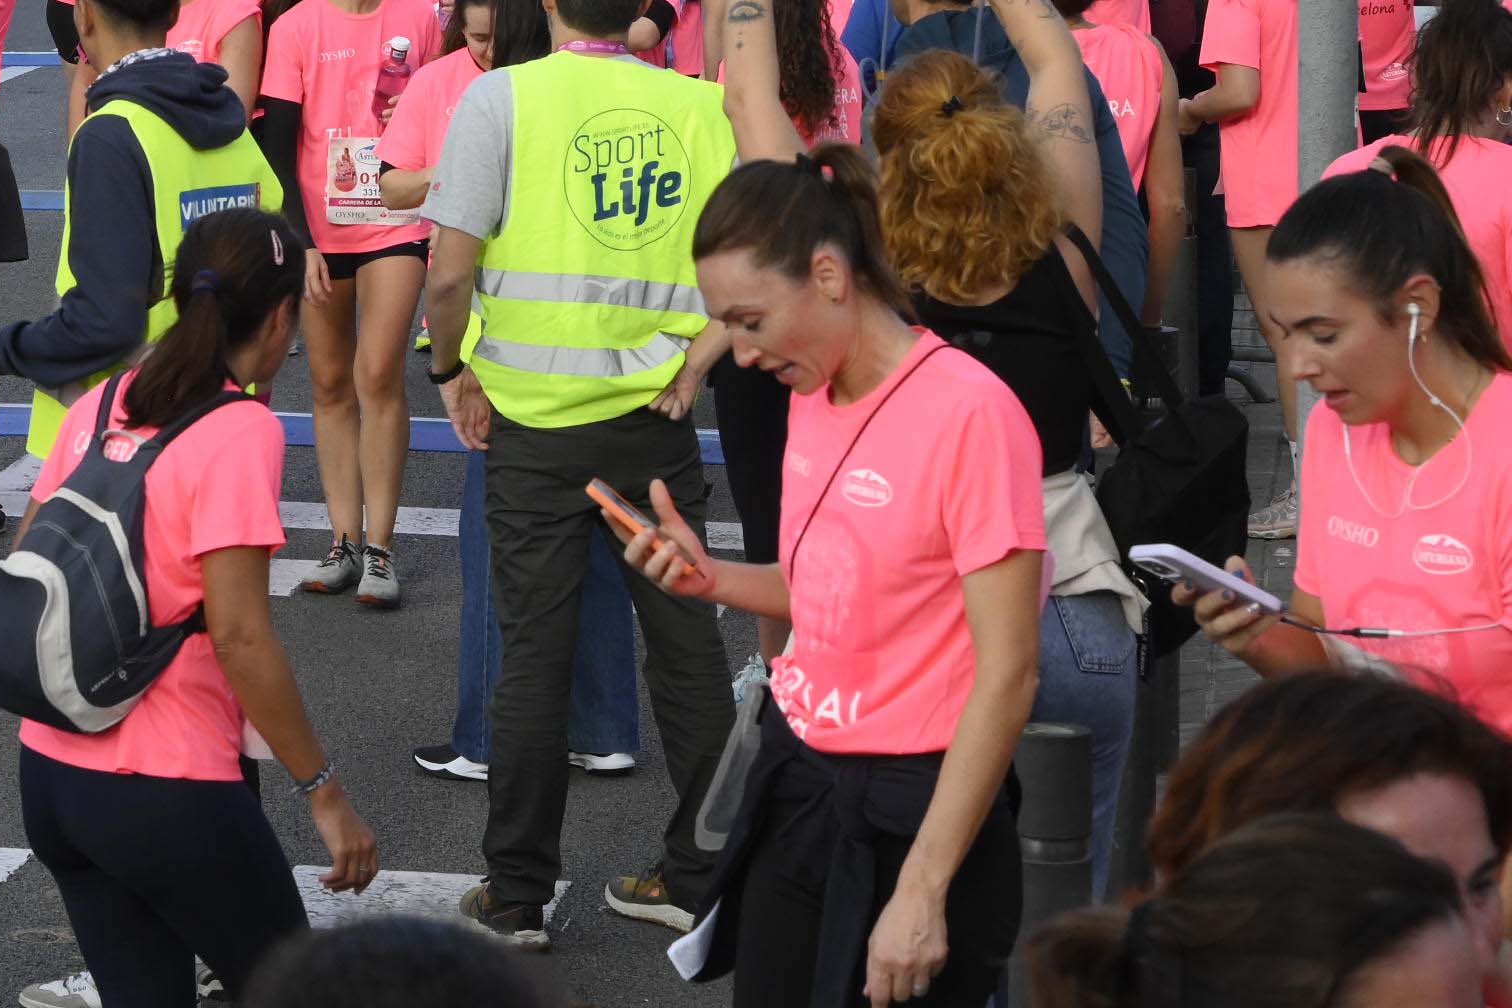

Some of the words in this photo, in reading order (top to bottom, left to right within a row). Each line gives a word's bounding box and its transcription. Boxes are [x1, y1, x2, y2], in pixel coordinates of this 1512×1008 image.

[1361, 2, 1395, 16] elona
[319, 48, 355, 63] OYSHO
[575, 124, 665, 175] Sport
[360, 173, 379, 185] 01
[591, 161, 682, 227] Life
